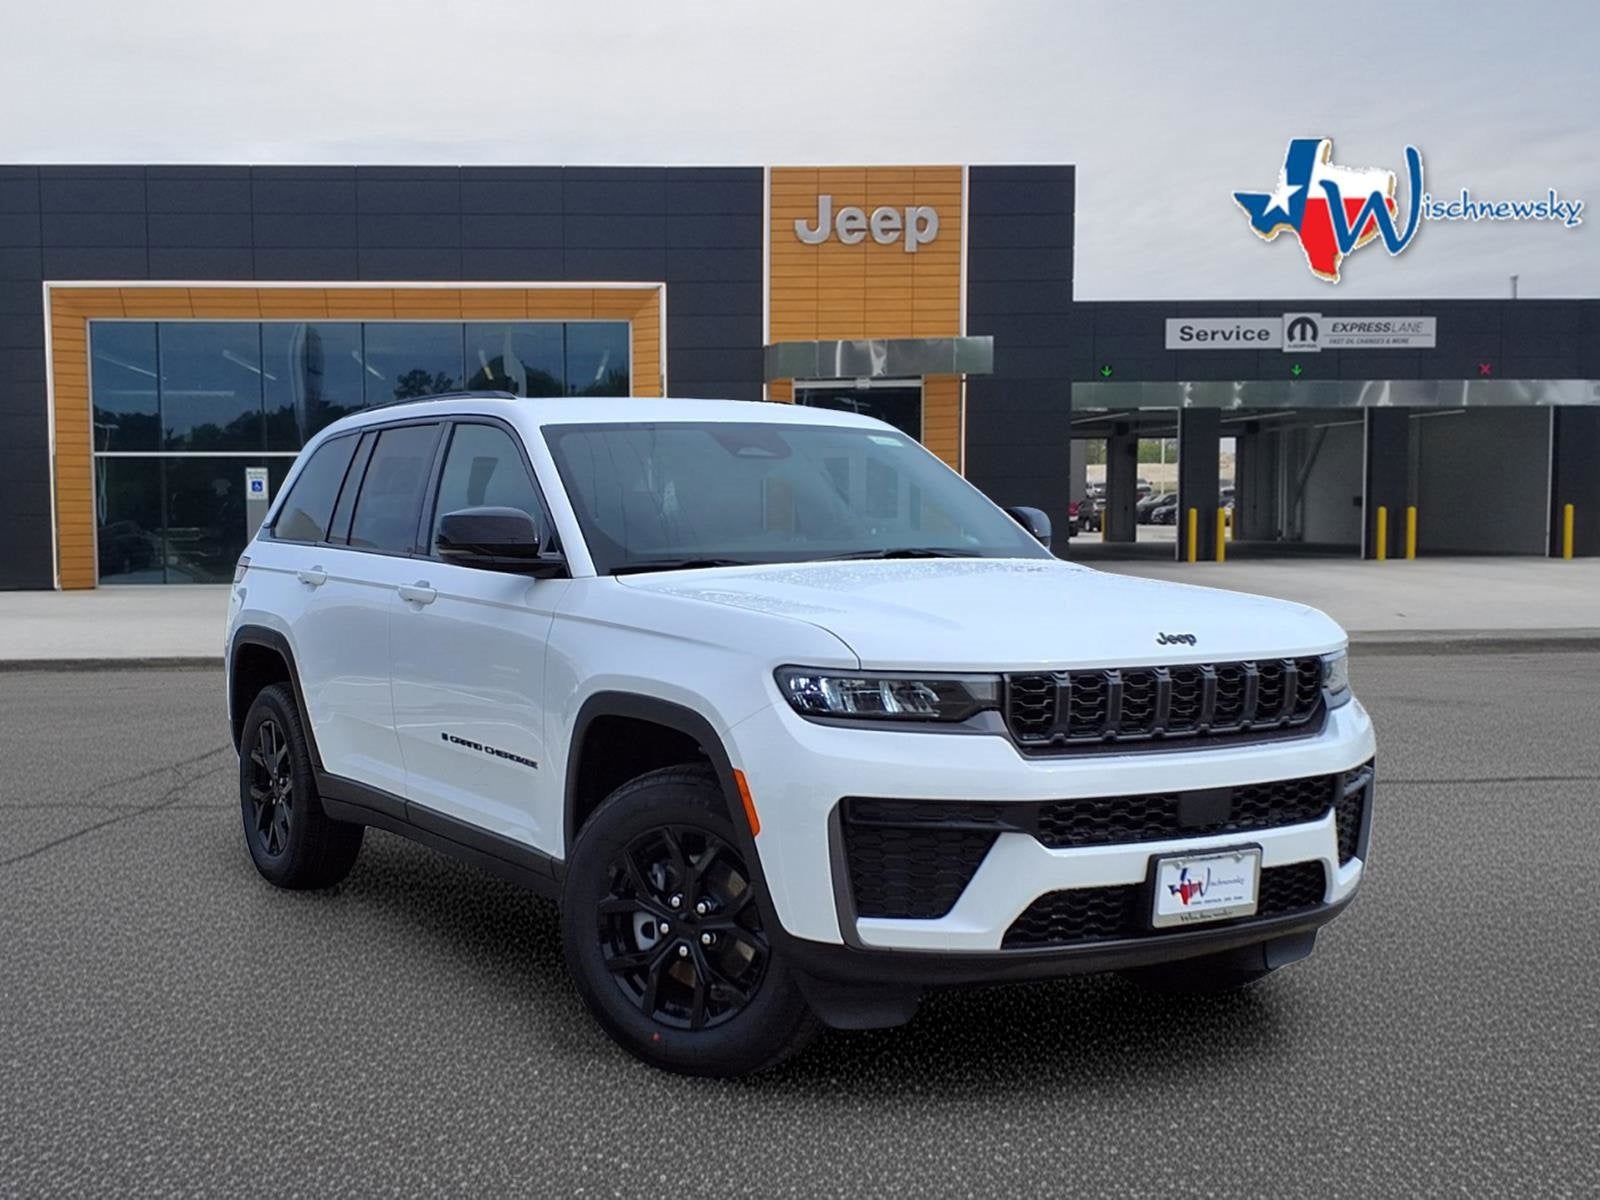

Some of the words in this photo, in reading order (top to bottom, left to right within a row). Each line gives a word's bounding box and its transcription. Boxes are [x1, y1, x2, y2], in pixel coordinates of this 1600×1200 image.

[794, 194, 939, 253] Jeep
[1179, 325, 1270, 341] Service
[1156, 631, 1197, 647] Jeep
[449, 735, 483, 752] GRAND
